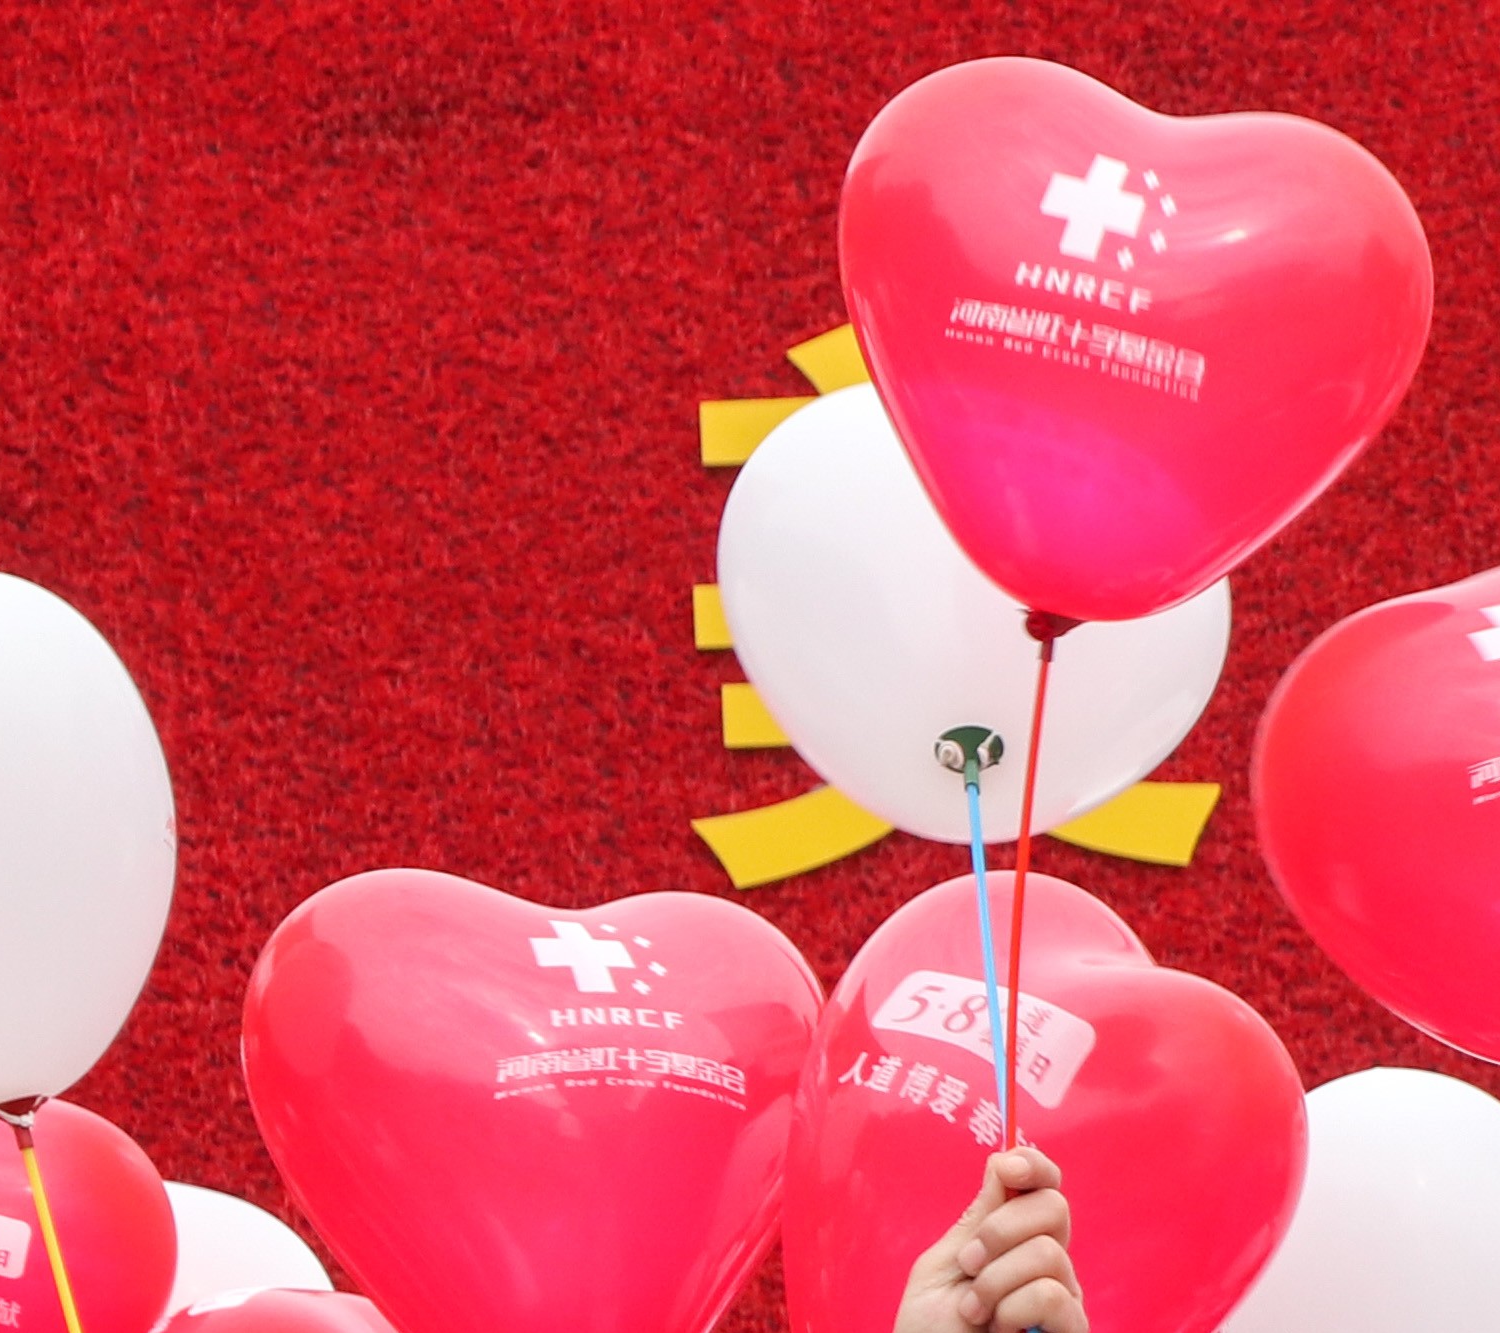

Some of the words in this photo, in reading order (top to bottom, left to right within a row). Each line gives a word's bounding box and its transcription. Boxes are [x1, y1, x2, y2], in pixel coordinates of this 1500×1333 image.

[1015, 261, 1153, 315] HNRCF
[551, 1007, 685, 1030] HNRCF
[838, 1051, 902, 1093] 人道
[899, 1061, 969, 1124] 博爱
